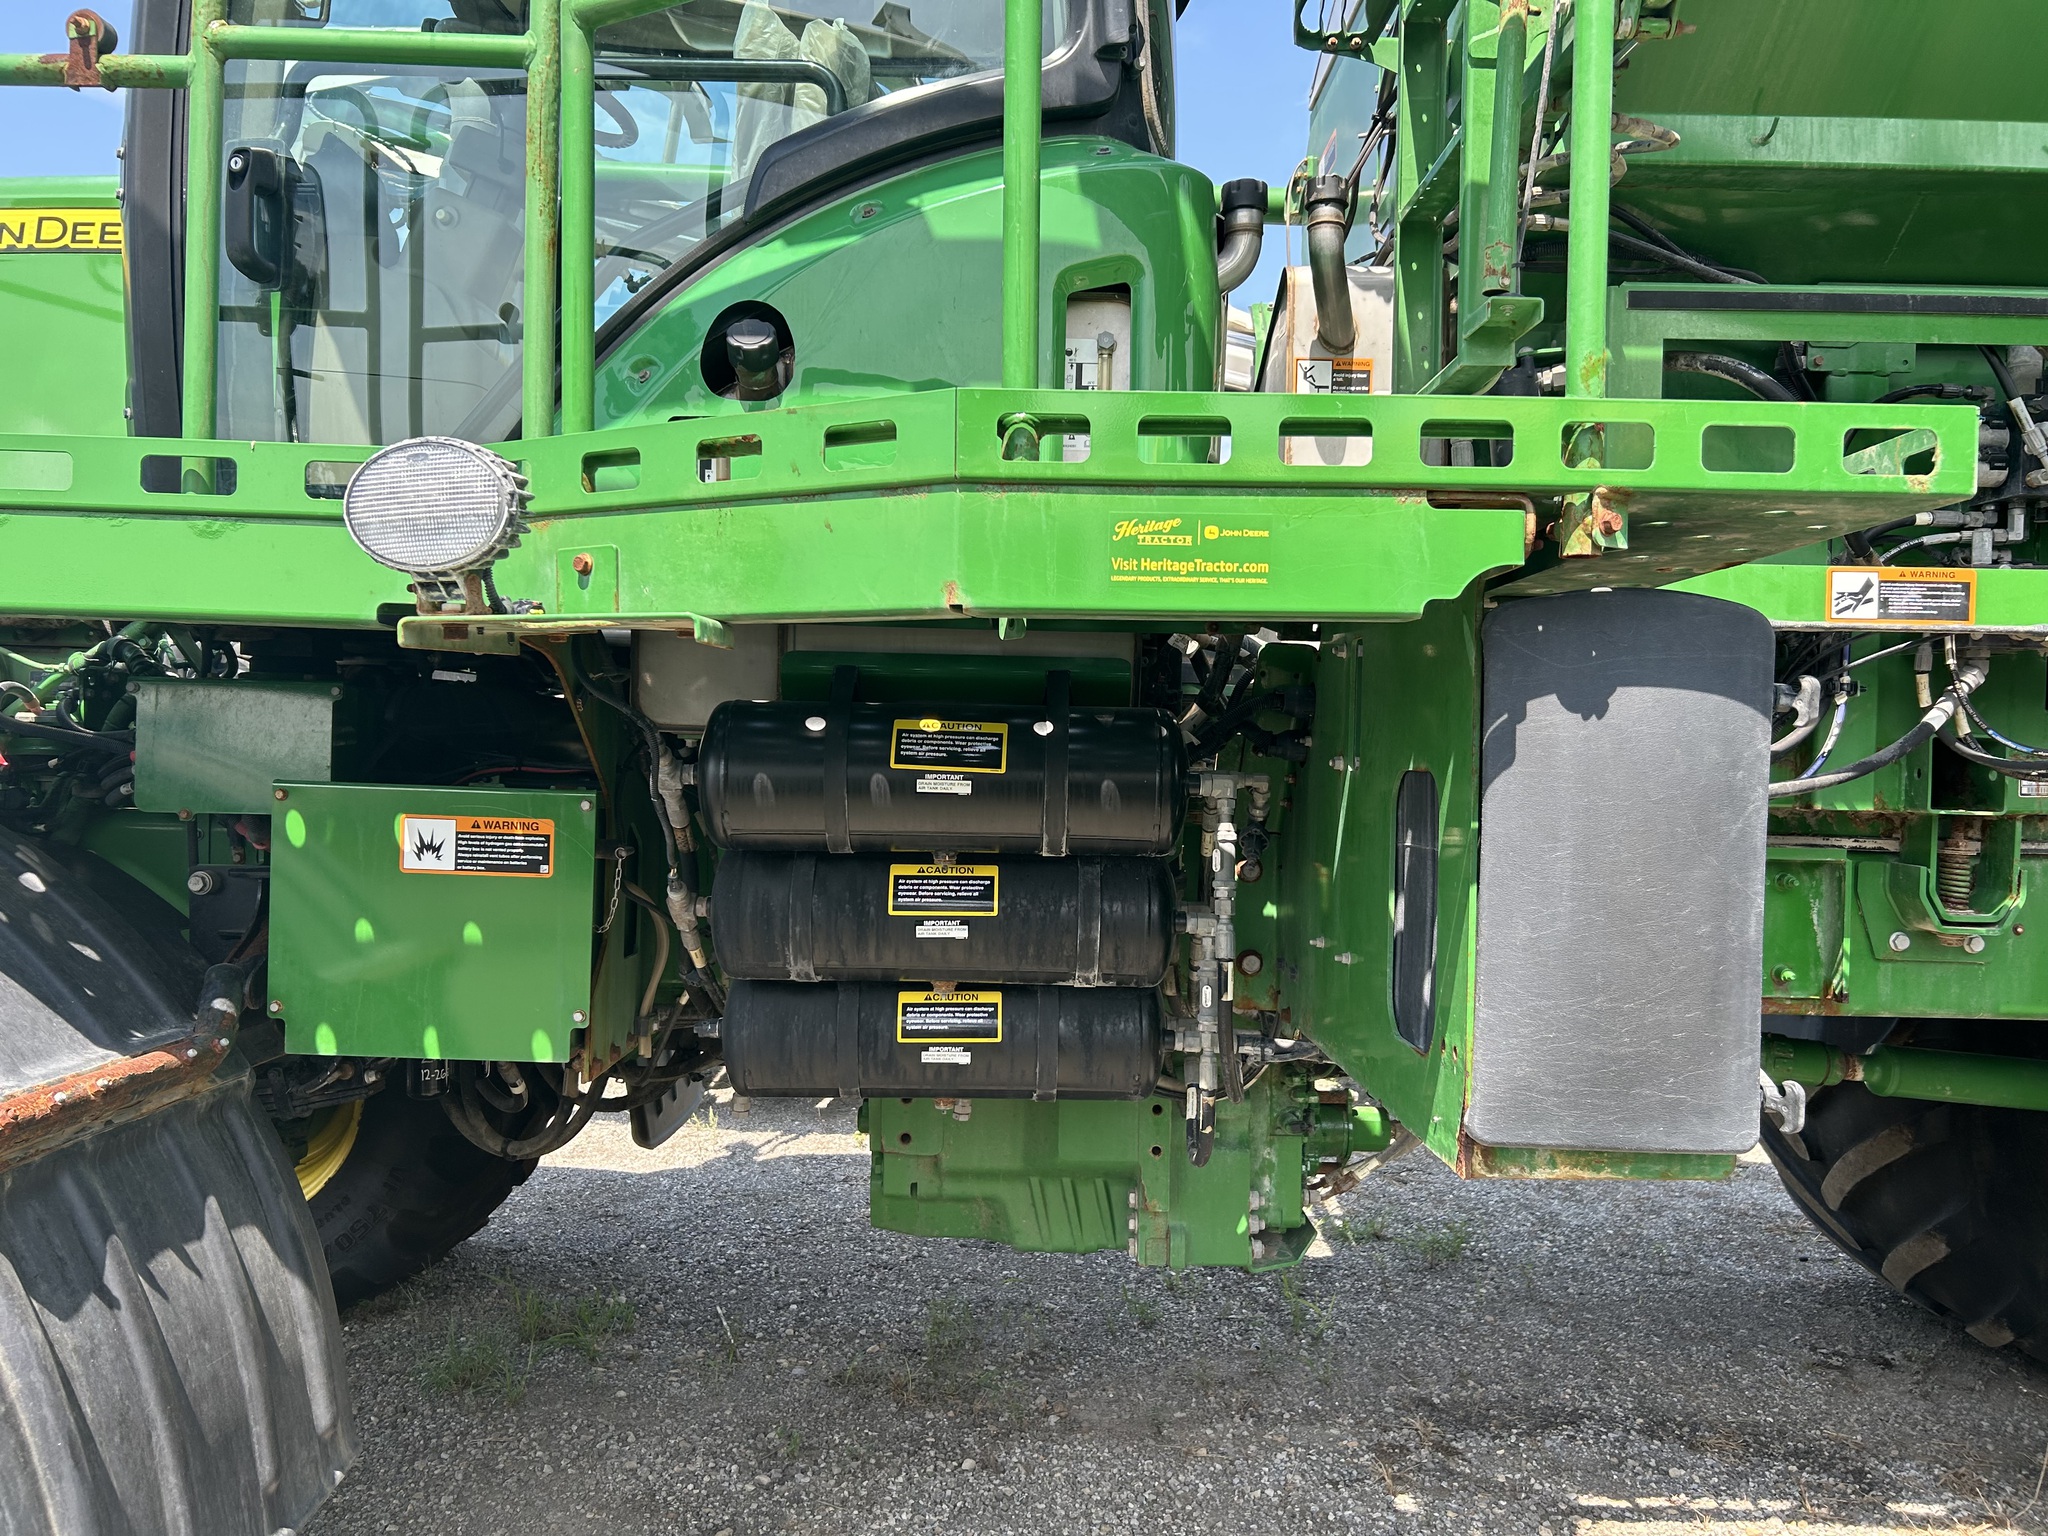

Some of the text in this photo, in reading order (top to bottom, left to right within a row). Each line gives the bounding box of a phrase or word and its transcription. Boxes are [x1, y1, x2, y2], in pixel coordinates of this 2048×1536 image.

[1112, 518, 1182, 541] Heritage
[1220, 529, 1269, 537] JOHN DEERE
[1138, 536, 1192, 545] TRACTOR
[1111, 557, 1269, 575] Visit HeritageTractor.com
[931, 721, 982, 730] CAUTION
[483, 820, 539, 831] WARNING
[926, 866, 974, 874] CAUTION
